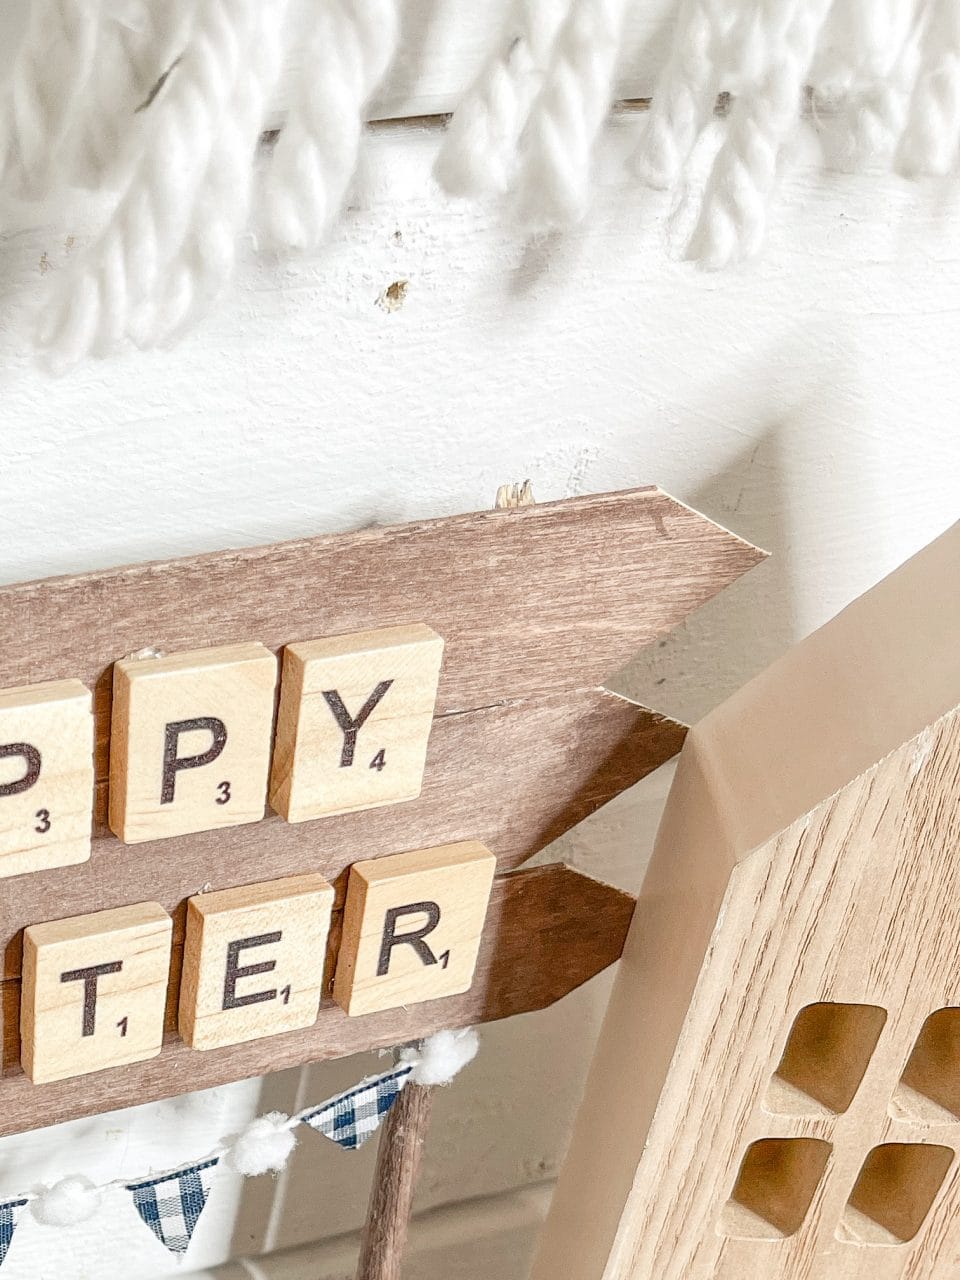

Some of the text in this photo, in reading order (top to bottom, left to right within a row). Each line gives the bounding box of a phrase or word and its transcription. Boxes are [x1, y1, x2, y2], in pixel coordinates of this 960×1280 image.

[369, 749, 386, 770] 4
[215, 780, 231, 806] 3
[35, 808, 52, 834] 3
[439, 949, 450, 970] 1
[280, 985, 291, 1005] 1
[117, 1016, 128, 1037] 1
